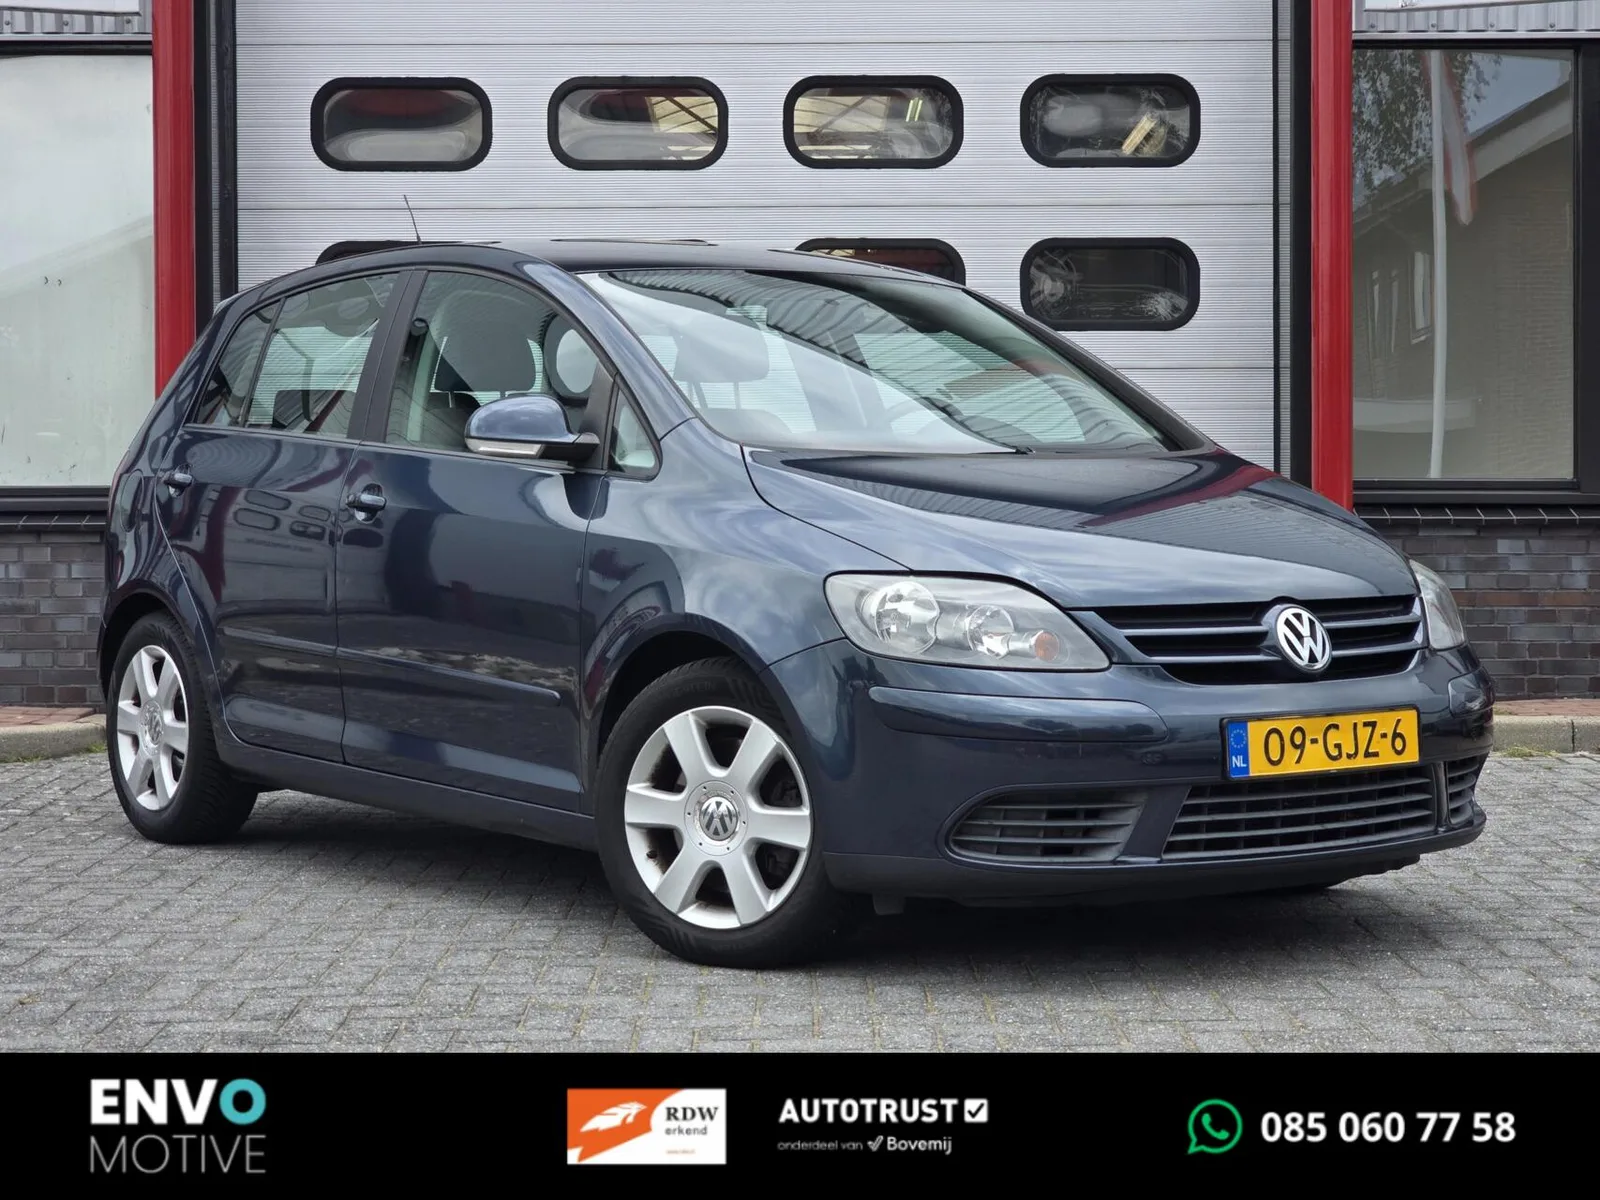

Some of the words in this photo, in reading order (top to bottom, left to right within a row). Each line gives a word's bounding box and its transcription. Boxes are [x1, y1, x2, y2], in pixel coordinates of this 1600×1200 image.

[1278, 607, 1331, 670] VW
[1232, 755, 1247, 768] NL
[1263, 718, 1407, 767] 09-GJZ-6
